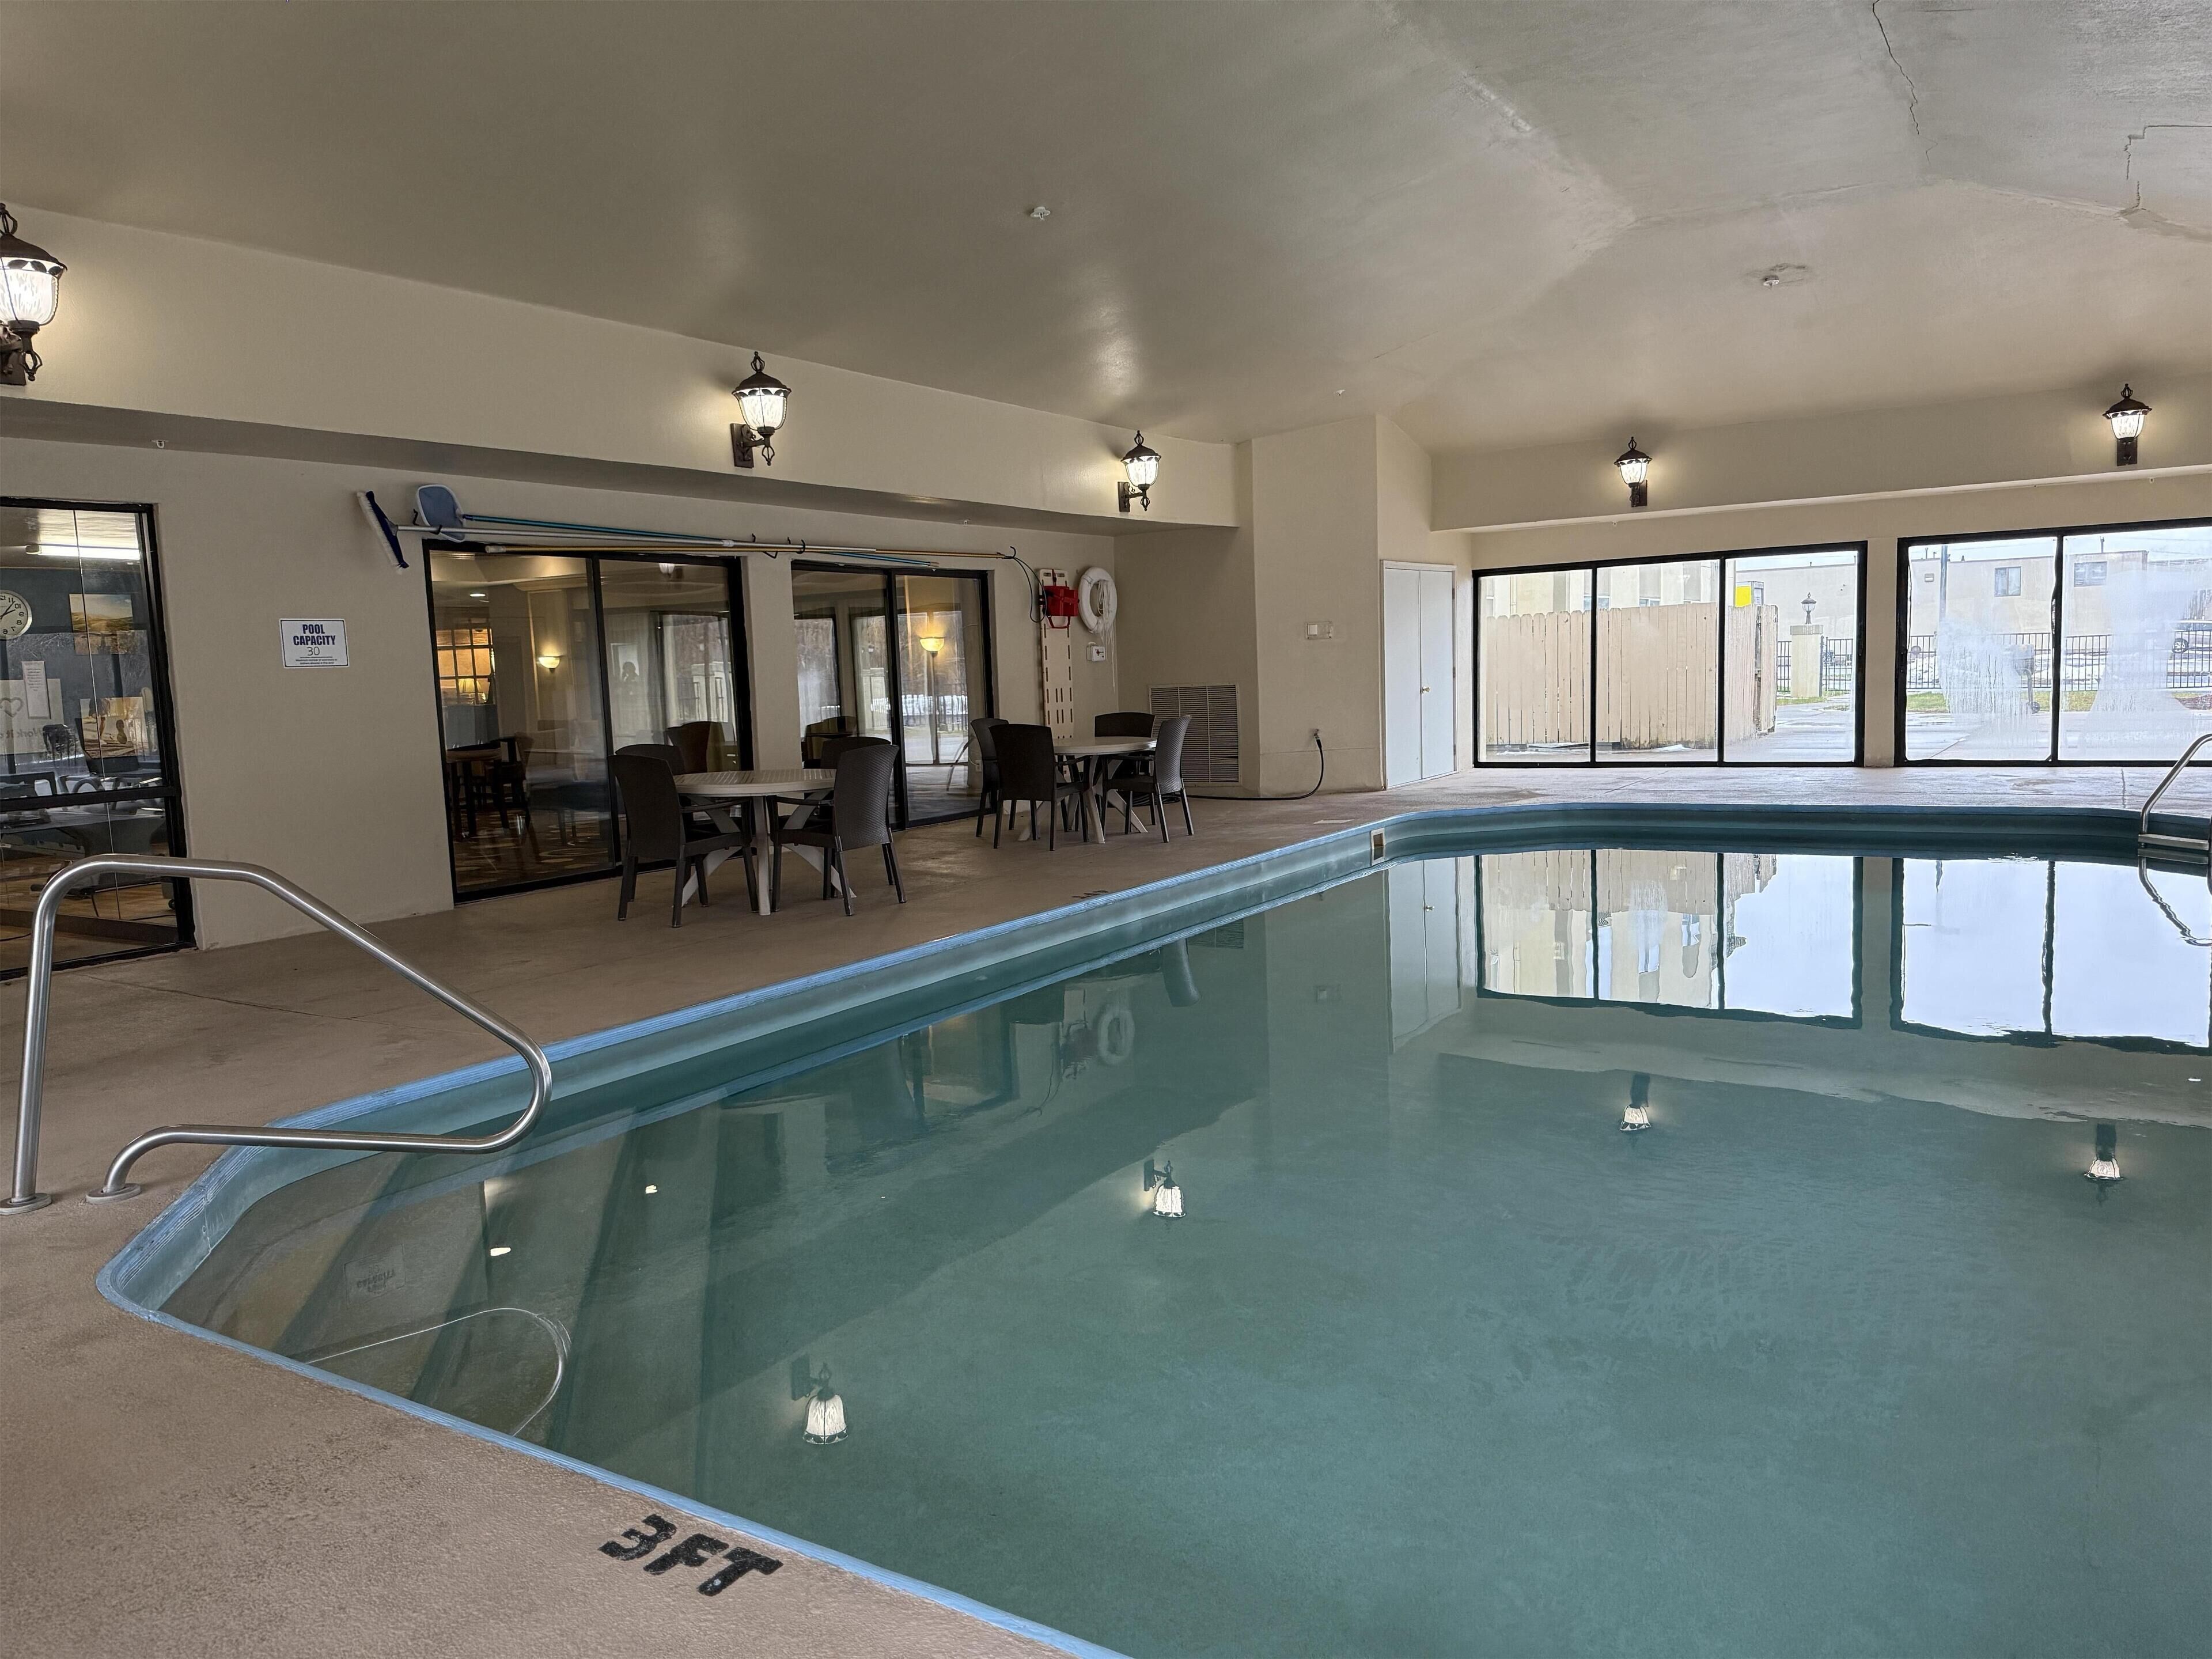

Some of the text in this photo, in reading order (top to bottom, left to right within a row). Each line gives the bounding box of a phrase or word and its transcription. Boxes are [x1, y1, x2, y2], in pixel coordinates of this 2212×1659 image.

[302, 624, 325, 634] POOL
[293, 635, 336, 646] CAPACITY
[306, 646, 320, 656] 30
[597, 1513, 784, 1596] 3FT
